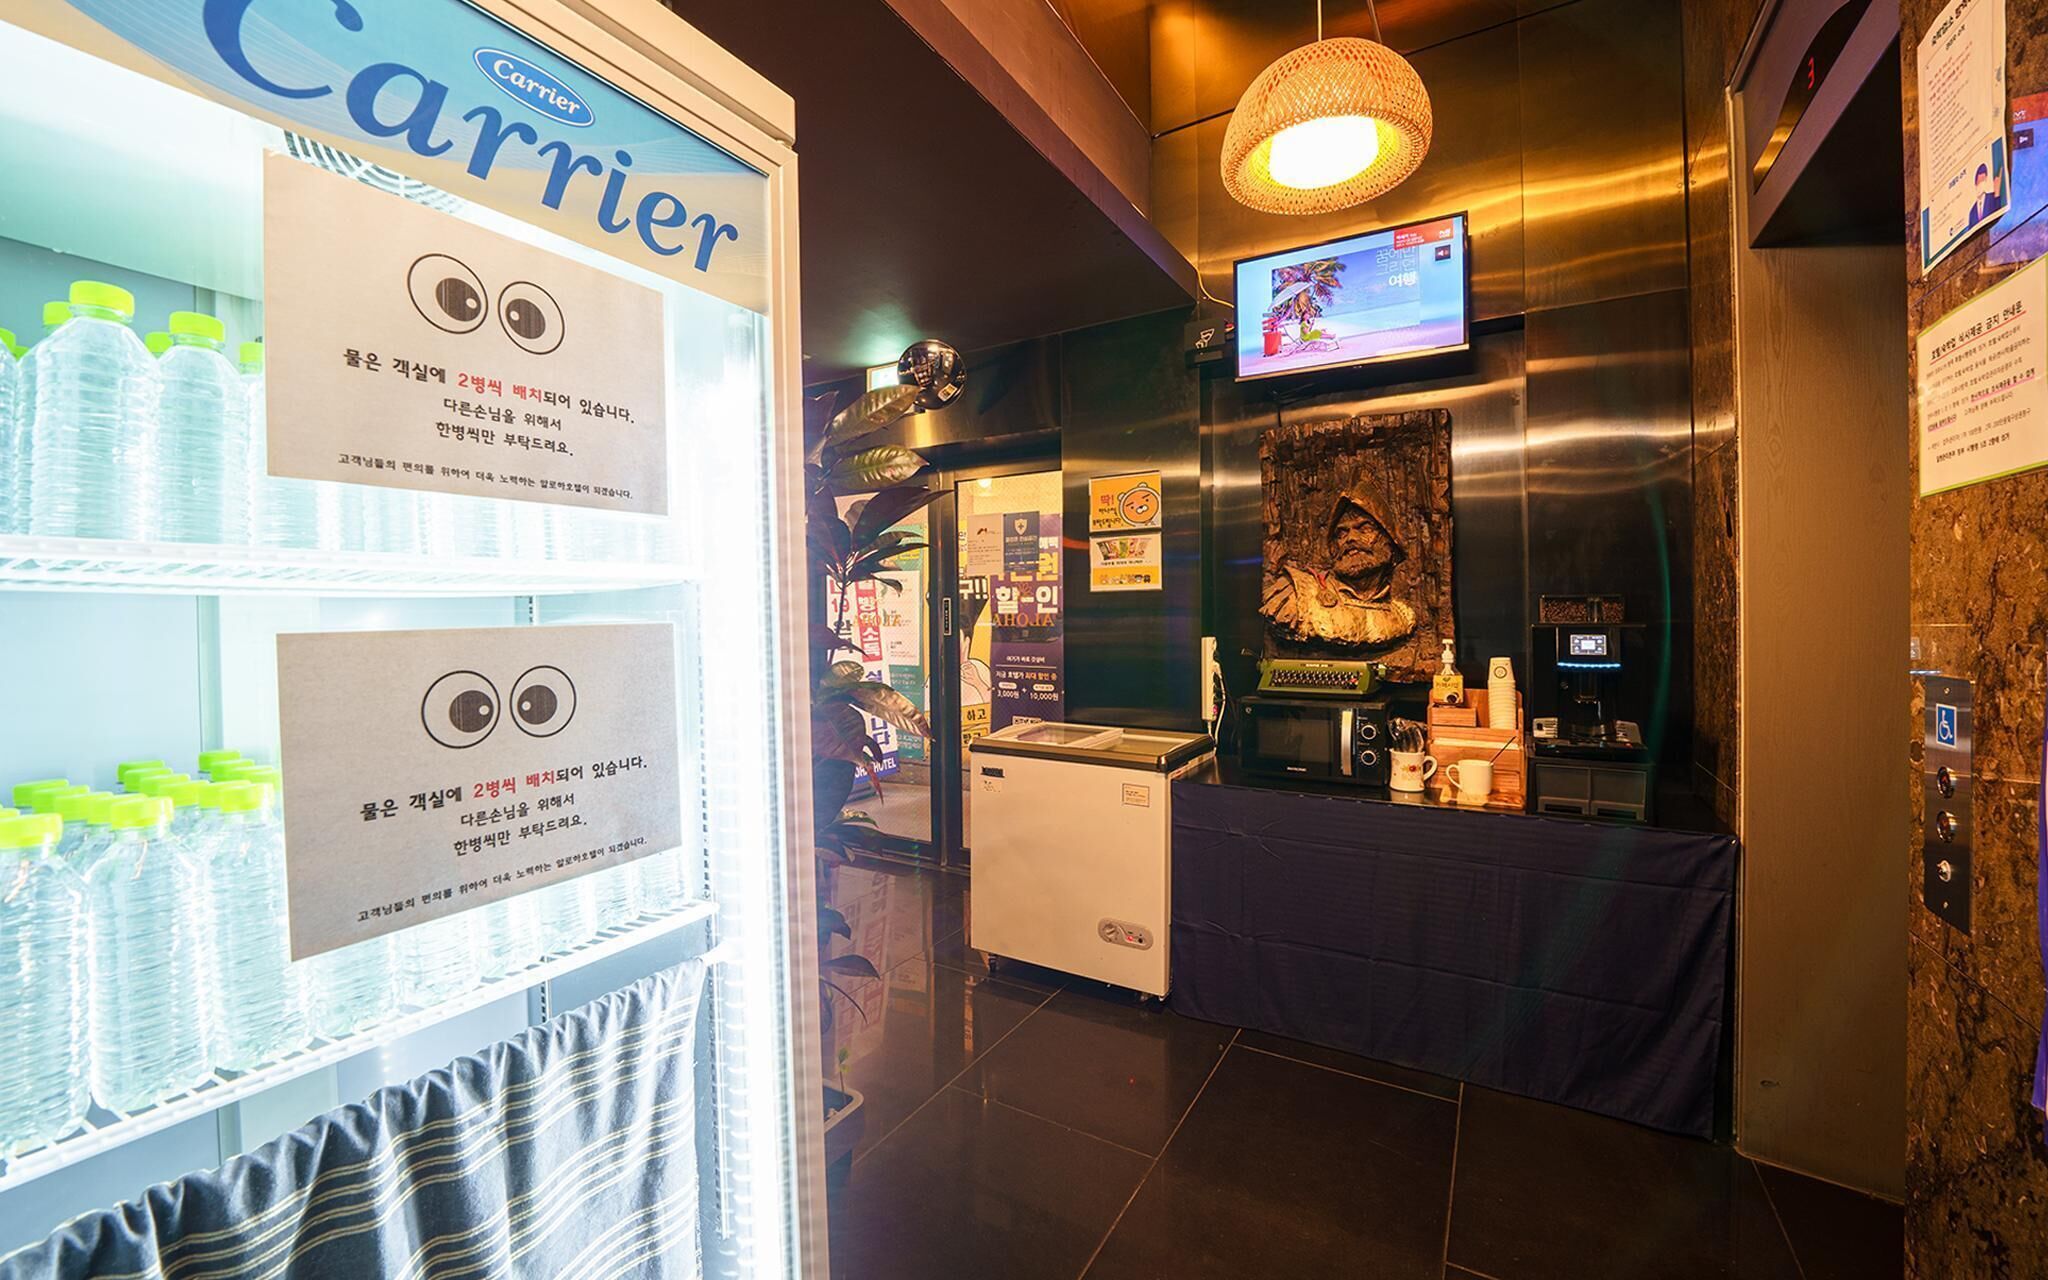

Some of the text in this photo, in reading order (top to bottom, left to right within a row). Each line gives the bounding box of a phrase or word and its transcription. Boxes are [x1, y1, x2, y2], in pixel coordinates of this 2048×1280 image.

[493, 58, 581, 116] Carrier
[1807, 56, 1815, 90] 3
[203, 0, 738, 272] Carrier
[1389, 271, 1417, 287] 여행
[1985, 314, 2000, 330] 금지
[343, 348, 635, 424] 물은 객실에 2병씩 배치되어 있습니다.
[443, 397, 562, 431] 다른손님을 위해서
[436, 421, 574, 456] 한병씩만 부탁드려요.
[338, 453, 396, 471] 고객님들의
[402, 461, 435, 475] 편의를
[441, 465, 471, 480] 위하여
[475, 470, 495, 482] 더욱
[499, 474, 536, 488] 노력하는
[1100, 494, 1114, 507] 딱!
[1030, 692, 1059, 702] 10,000원
[873, 757, 897, 773] HOTEL
[360, 756, 648, 821] 물은 객실에 2병씩 배치되어 있습니다.
[460, 792, 575, 827] 다른손님을 위해서
[454, 814, 588, 857] 한병씩만 부탁드려요.
[357, 896, 415, 922] 고객님들의
[421, 887, 453, 905] 편의를
[459, 878, 488, 895] 위하여
[493, 873, 511, 885] 더욱
[516, 862, 552, 880] 노력하는
